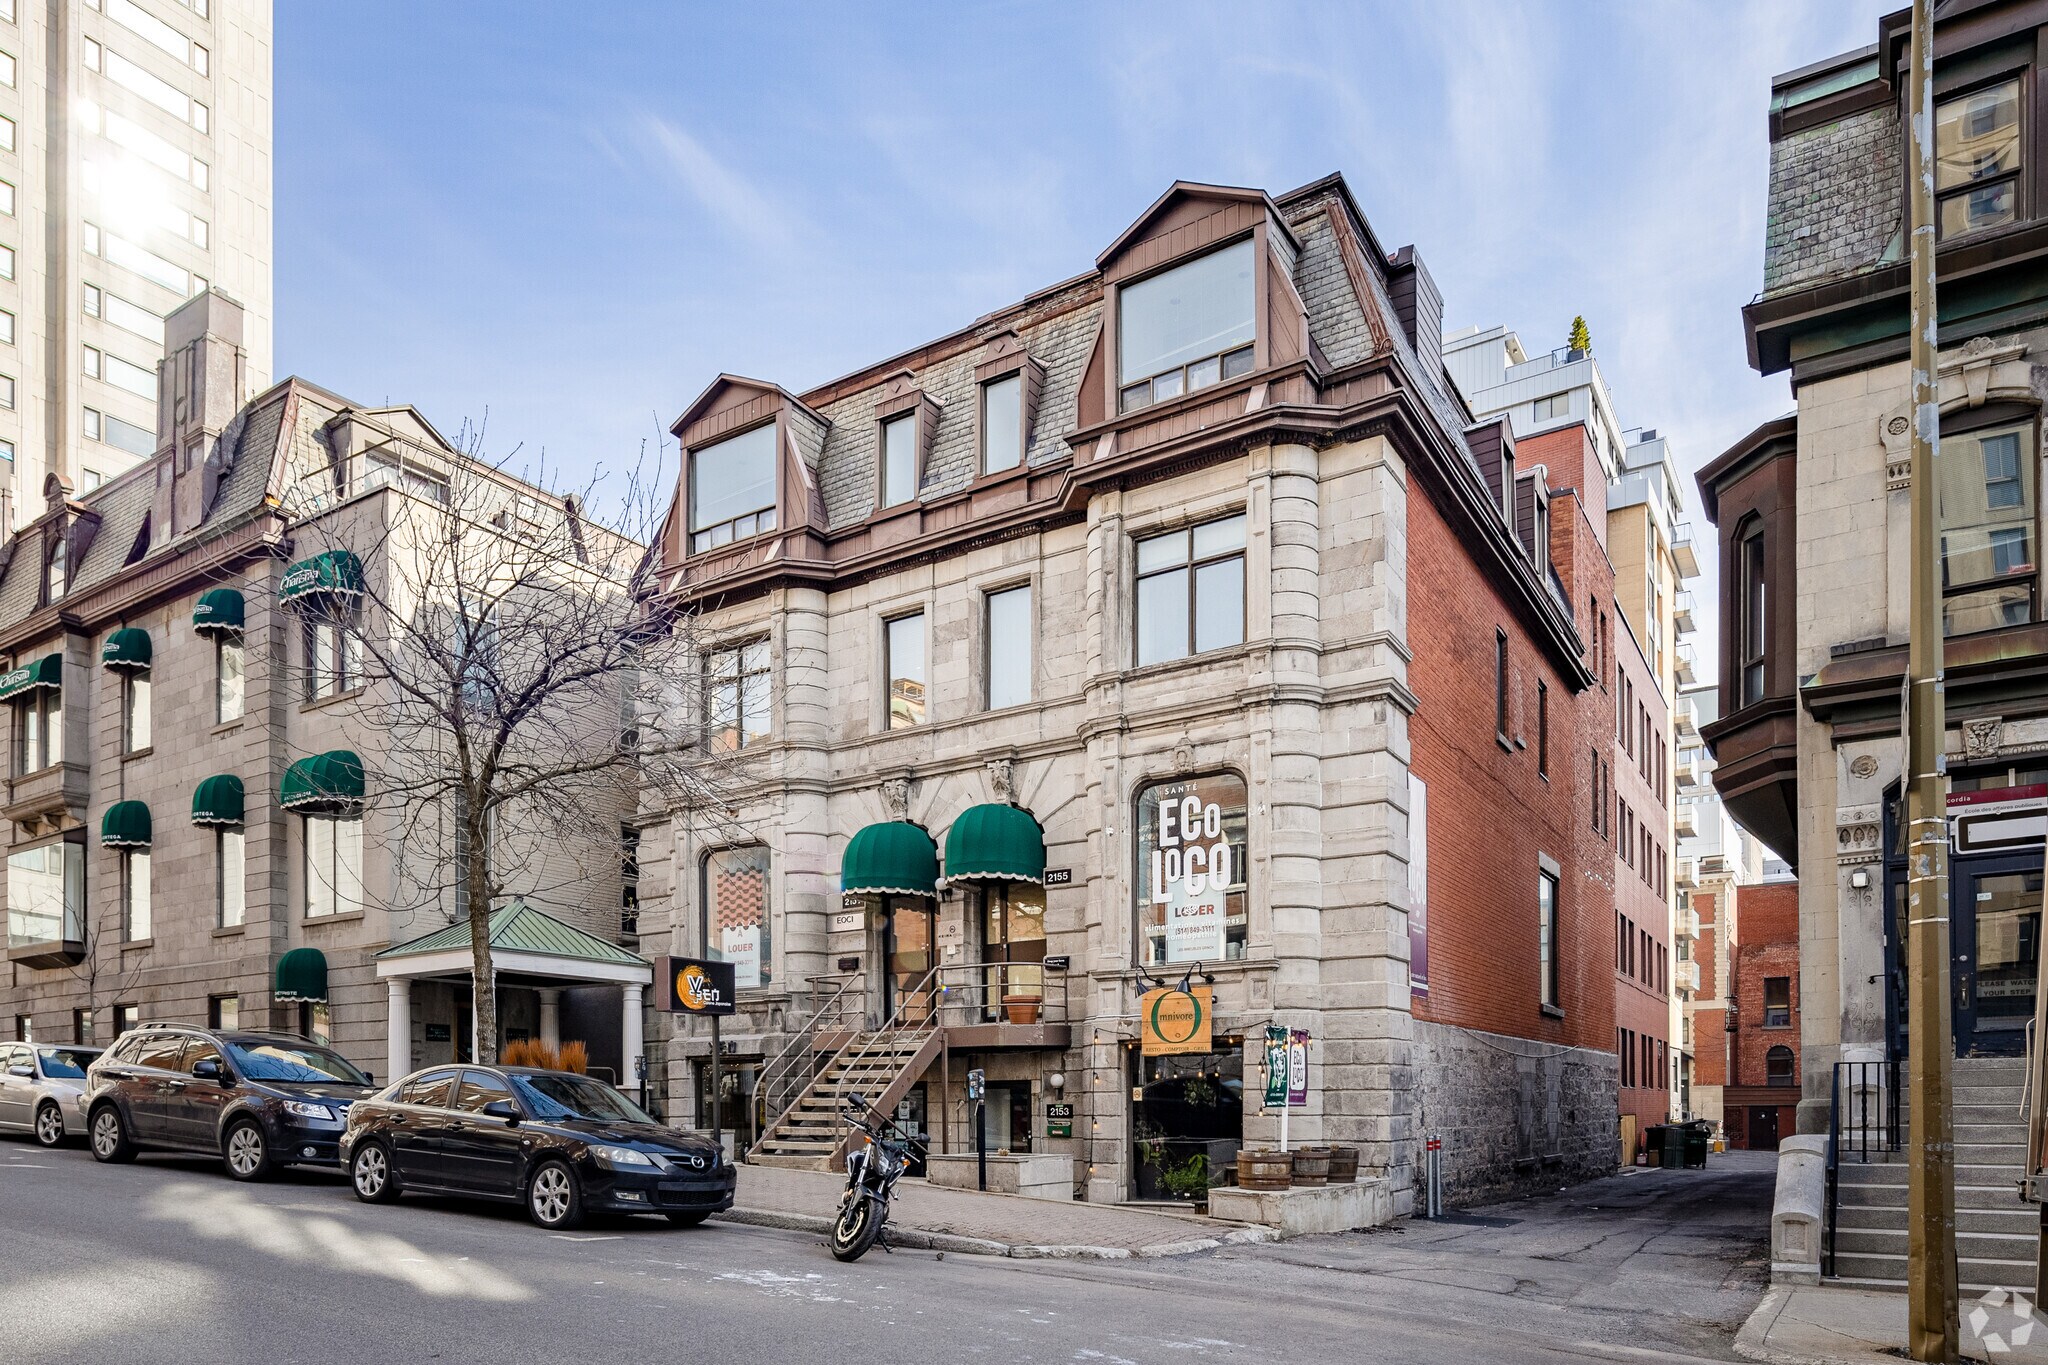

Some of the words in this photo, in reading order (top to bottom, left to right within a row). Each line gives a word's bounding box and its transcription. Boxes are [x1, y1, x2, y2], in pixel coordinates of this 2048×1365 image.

[1164, 782, 1198, 796] SANTÉ
[1946, 796, 1971, 804] cordia
[1993, 804, 2014, 812] affaires
[1047, 871, 1069, 882] 2155
[836, 915, 854, 925] EOCI
[728, 943, 754, 953] LOUER
[1050, 1107, 1070, 1116] 2153
